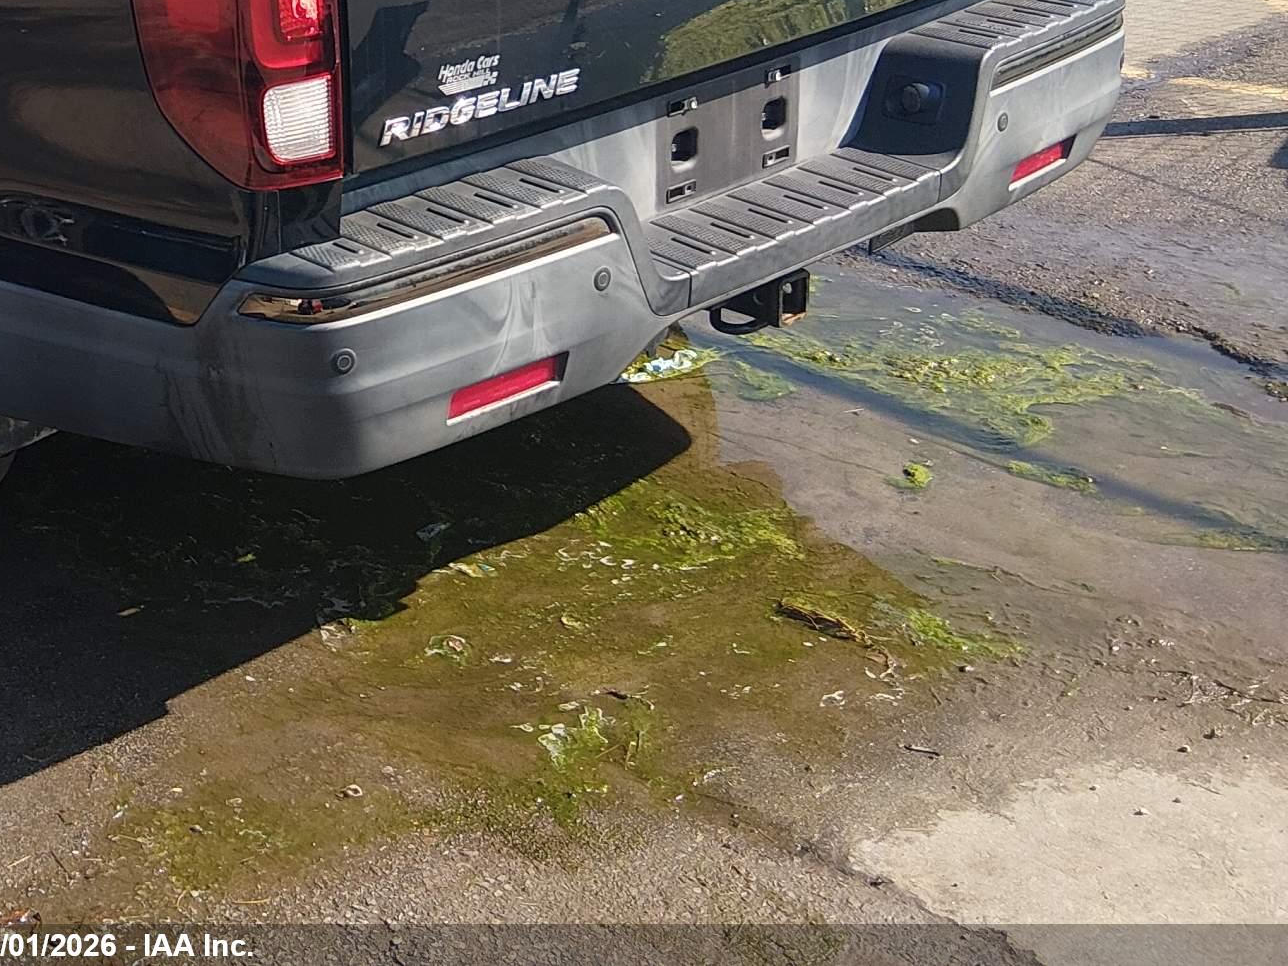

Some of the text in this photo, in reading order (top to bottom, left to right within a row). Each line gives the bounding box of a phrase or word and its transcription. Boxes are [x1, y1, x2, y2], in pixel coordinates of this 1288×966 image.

[438, 55, 500, 83] Honda Cars
[379, 68, 581, 147] RIDGELINE
